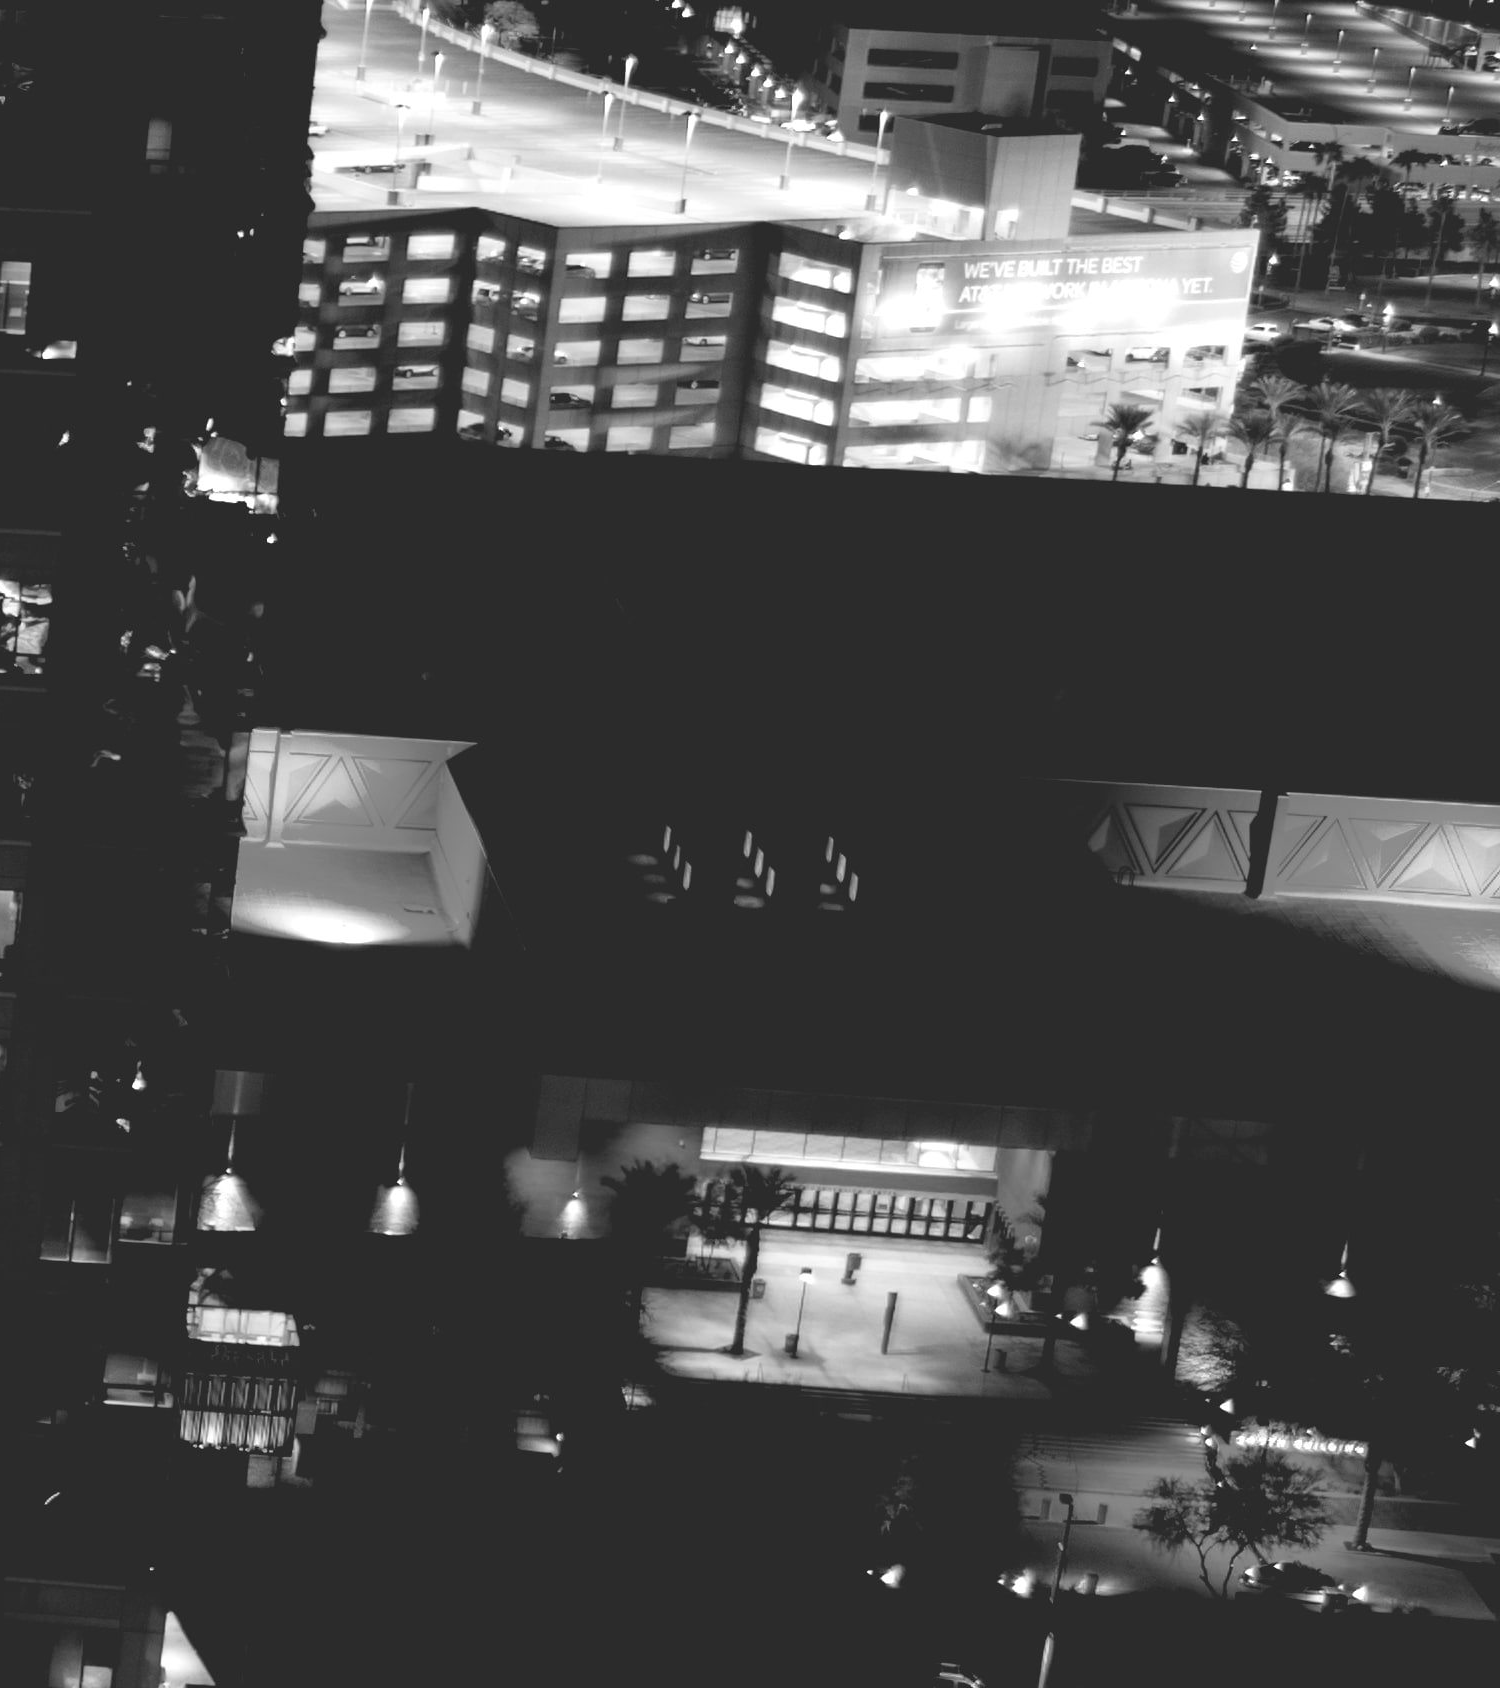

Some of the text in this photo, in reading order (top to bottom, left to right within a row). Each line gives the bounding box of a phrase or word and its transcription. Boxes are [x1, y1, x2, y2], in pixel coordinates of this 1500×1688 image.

[964, 256, 1142, 279] WE'VE BUILT THE BEST
[1181, 277, 1212, 294] YET.
